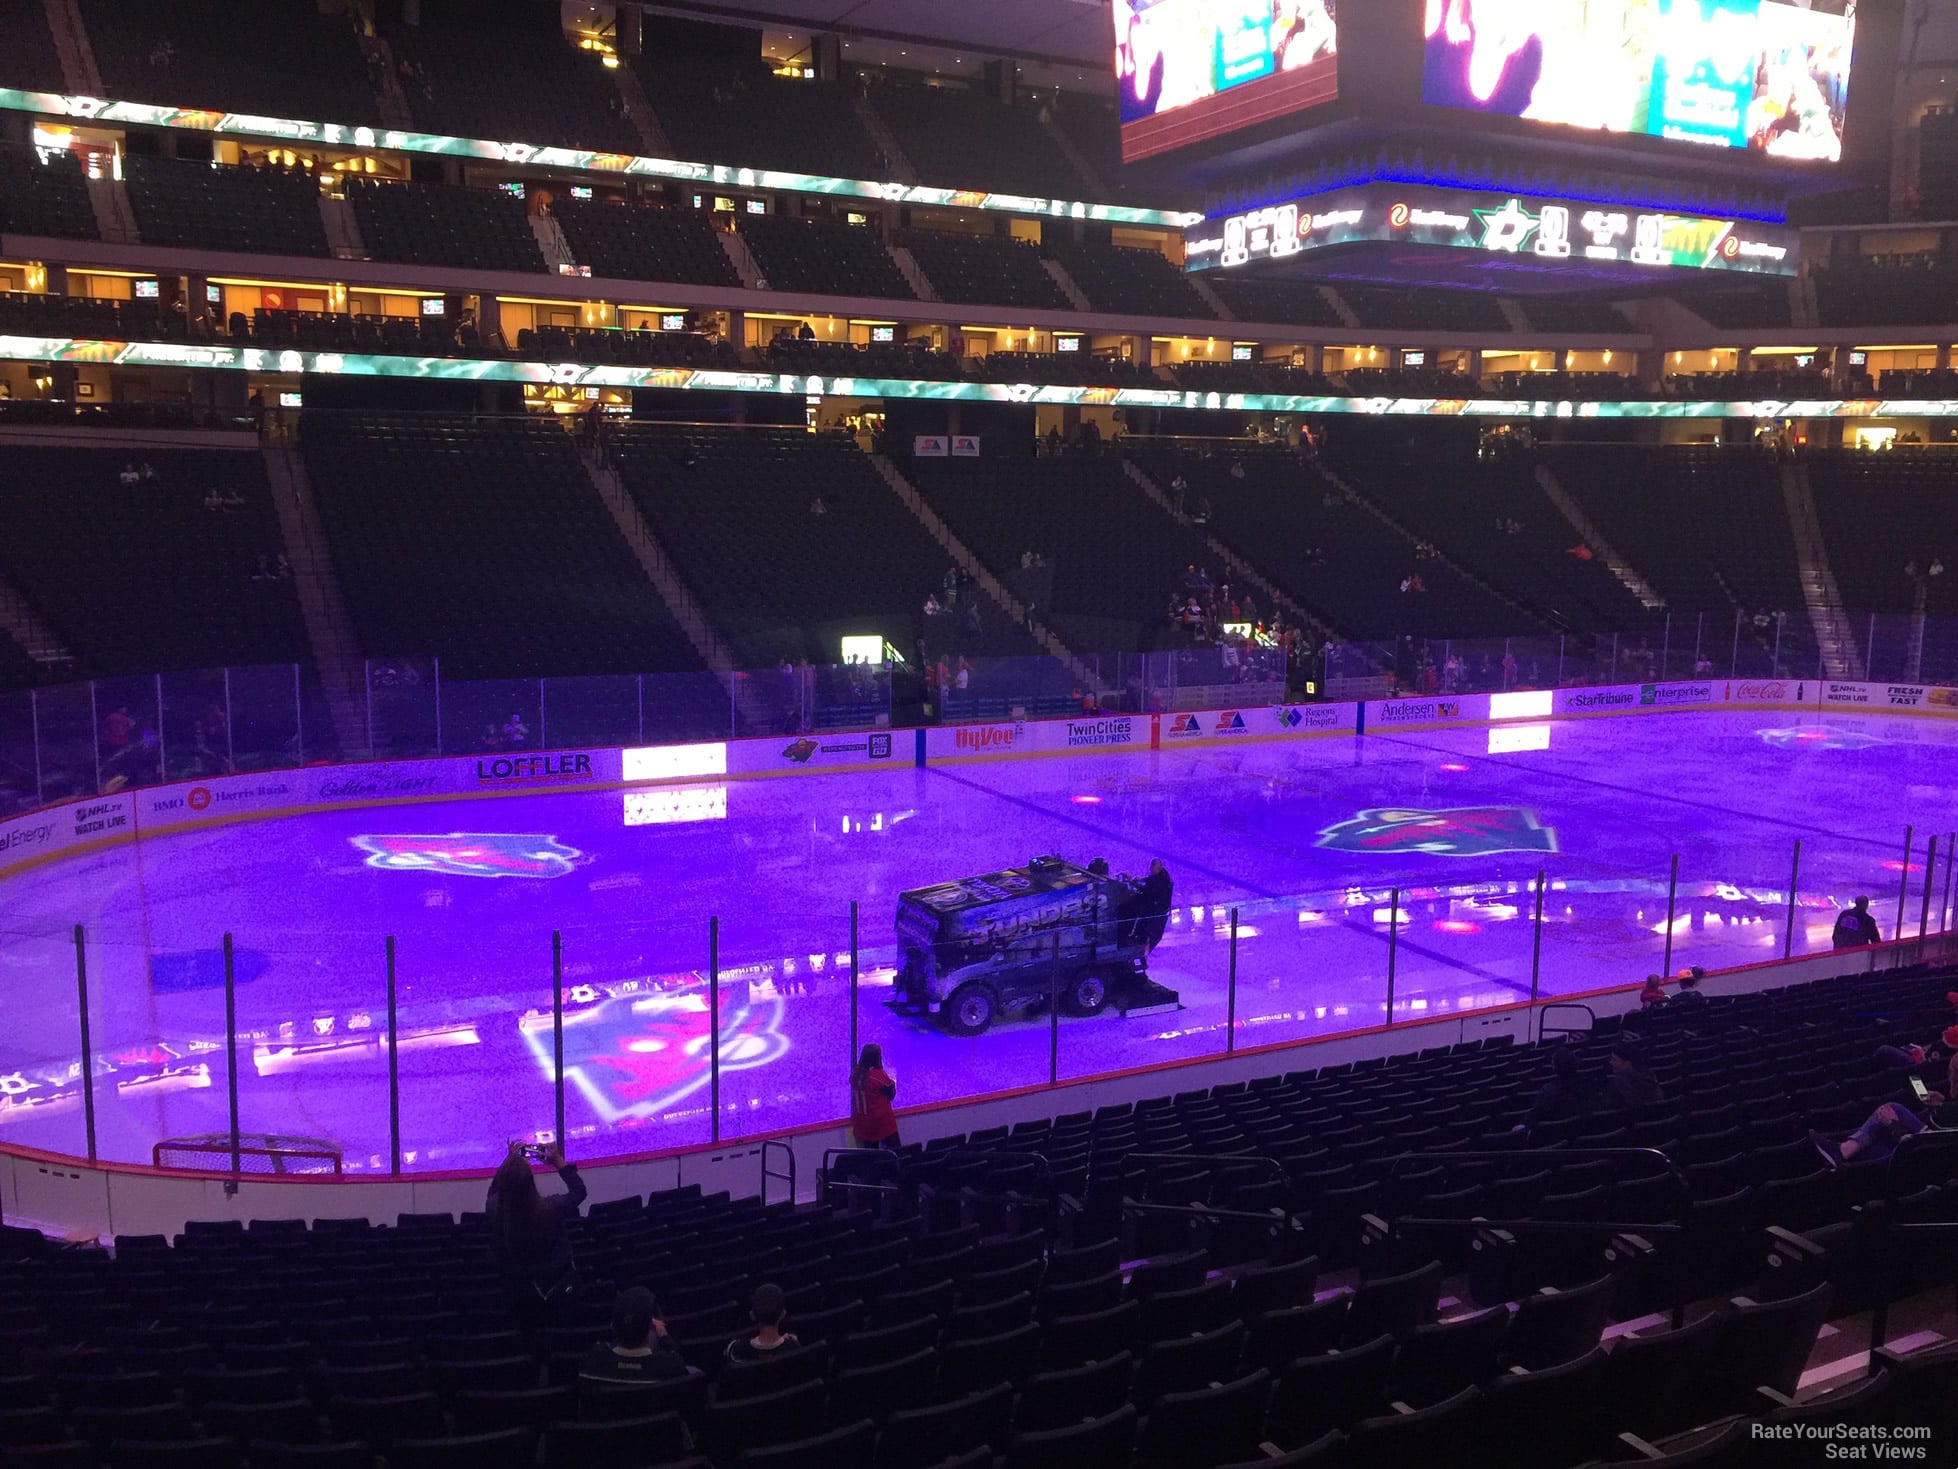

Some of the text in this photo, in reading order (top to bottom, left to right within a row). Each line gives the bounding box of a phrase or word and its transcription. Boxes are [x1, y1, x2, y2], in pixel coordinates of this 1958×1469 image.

[1887, 686, 1923, 696] FRESH
[1575, 692, 1634, 707] StarTribune
[1828, 694, 1851, 702] WATCH
[1890, 697, 1918, 705] FAST
[1305, 707, 1336, 718] Regions
[1381, 702, 1434, 717] Andersen
[1067, 720, 1131, 736] TwinCities
[1305, 715, 1338, 728] Hospital
[872, 736, 888, 745] FOX
[1068, 733, 1131, 746] PIONEER PRESS
[477, 753, 592, 779] LOFFLER
[153, 784, 289, 812] BMO Harris Bank
[75, 815, 126, 836] WATCH LIVE
